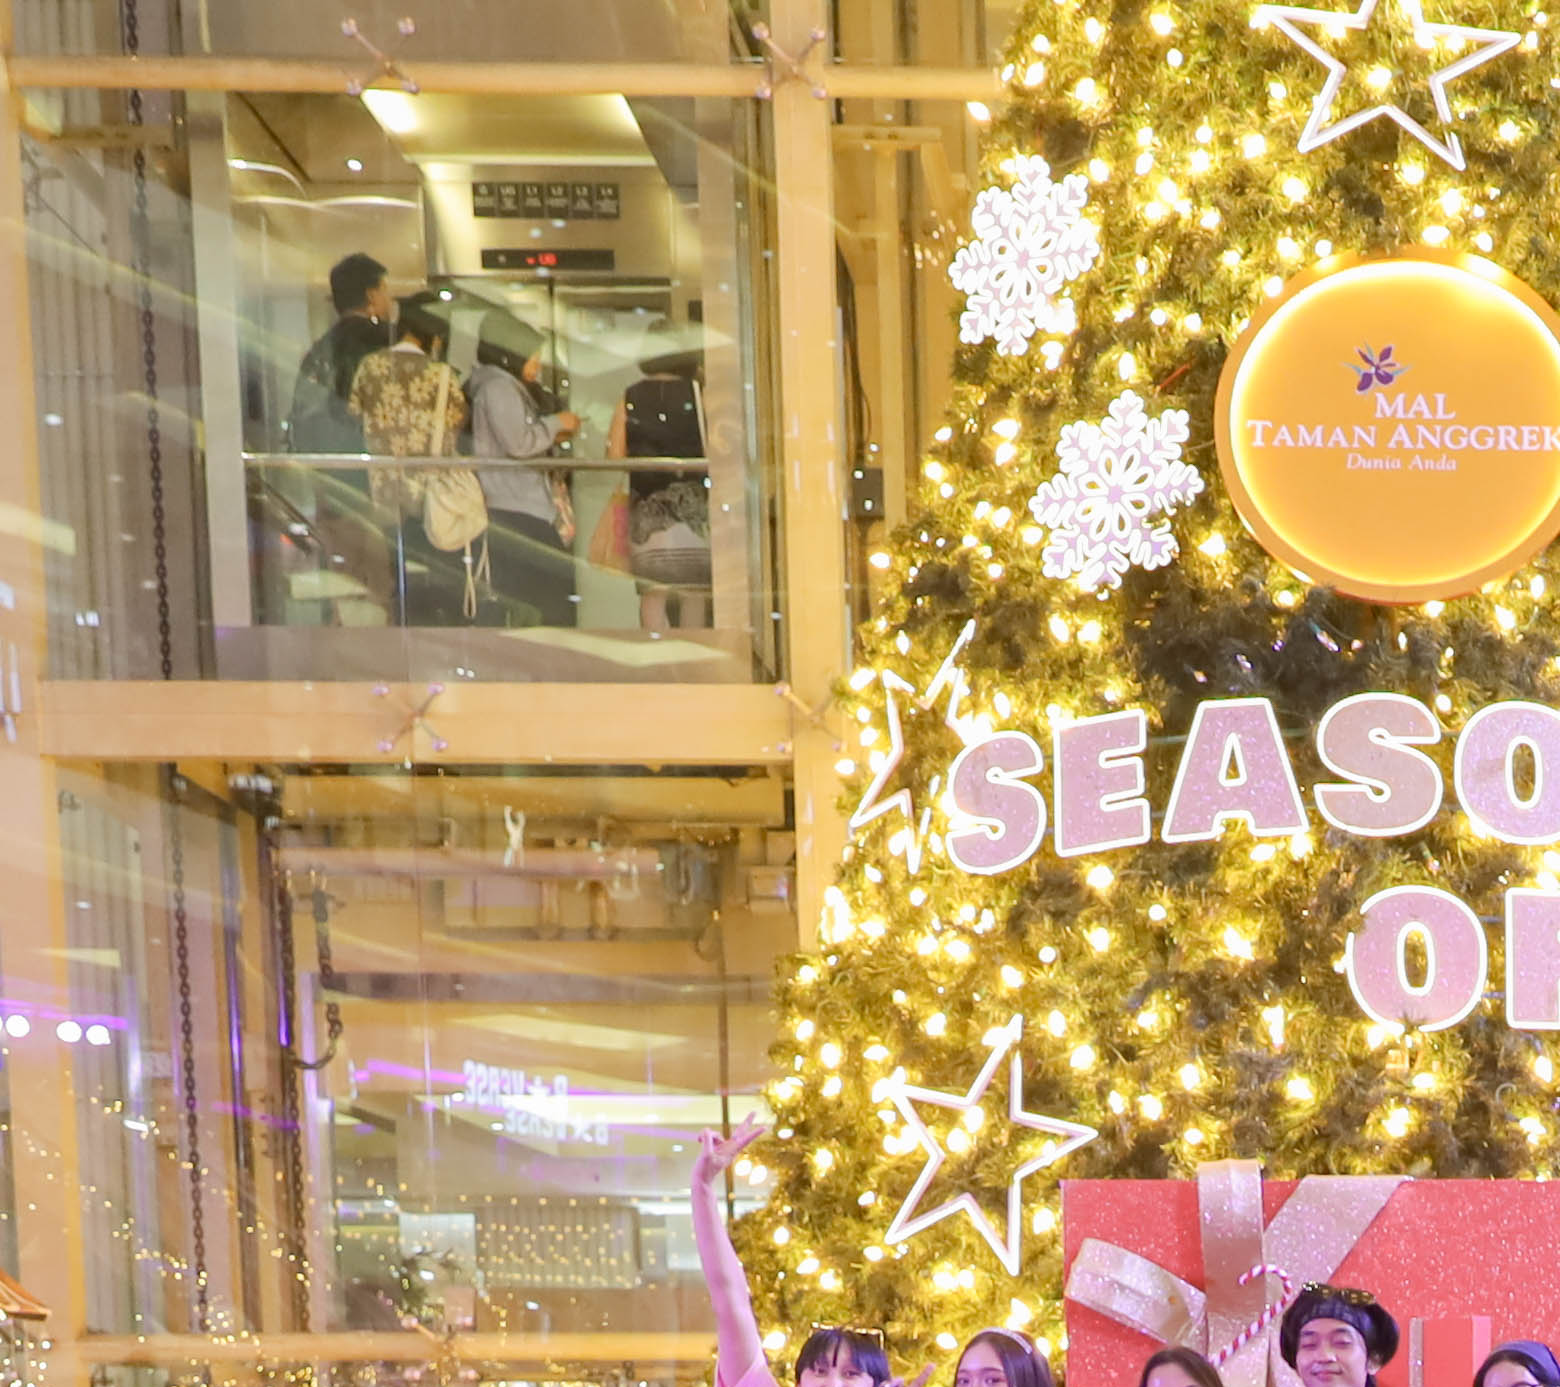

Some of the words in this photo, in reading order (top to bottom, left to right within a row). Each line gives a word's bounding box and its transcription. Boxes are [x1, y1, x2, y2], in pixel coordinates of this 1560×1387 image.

[1375, 392, 1456, 420] MAL
[1246, 420, 1377, 449] TAMAN
[1346, 453, 1401, 470] Dunia
[1408, 453, 1457, 472] Anda
